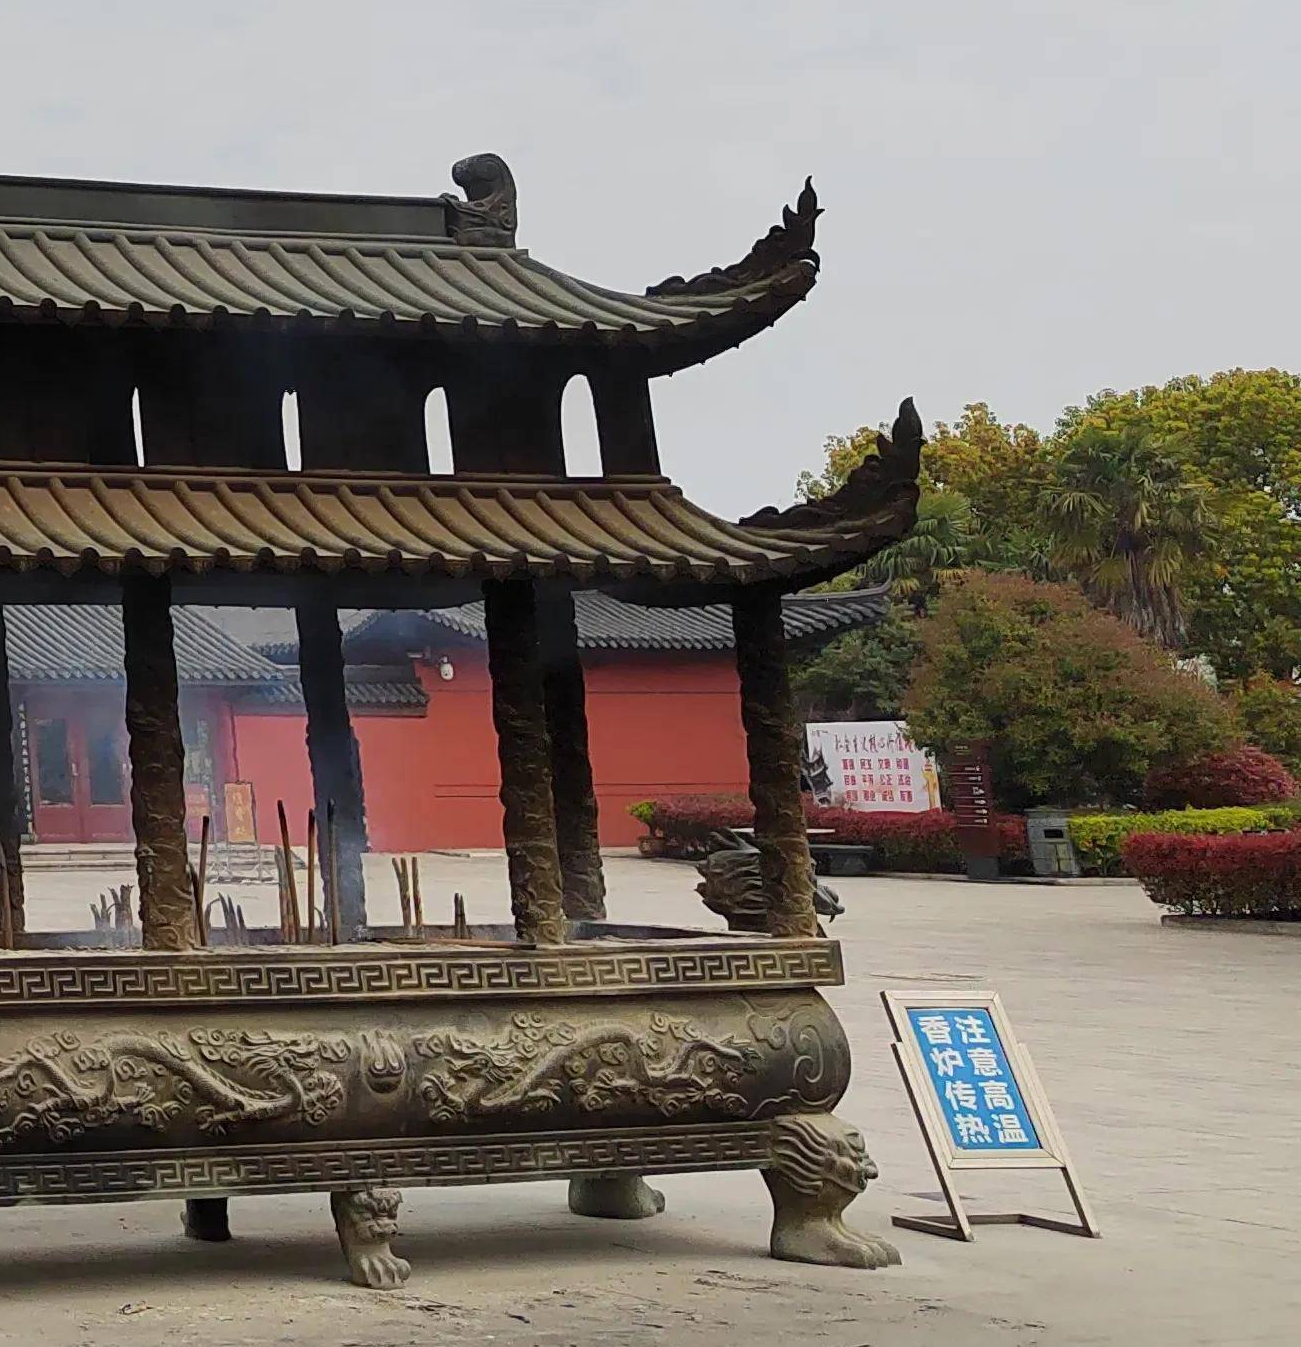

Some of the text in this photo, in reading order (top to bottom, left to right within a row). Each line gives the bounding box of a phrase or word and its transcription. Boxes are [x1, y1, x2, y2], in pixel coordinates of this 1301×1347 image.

[917, 1015, 994, 1144] 香炉传热
[954, 1015, 1029, 1143] 注意高温
